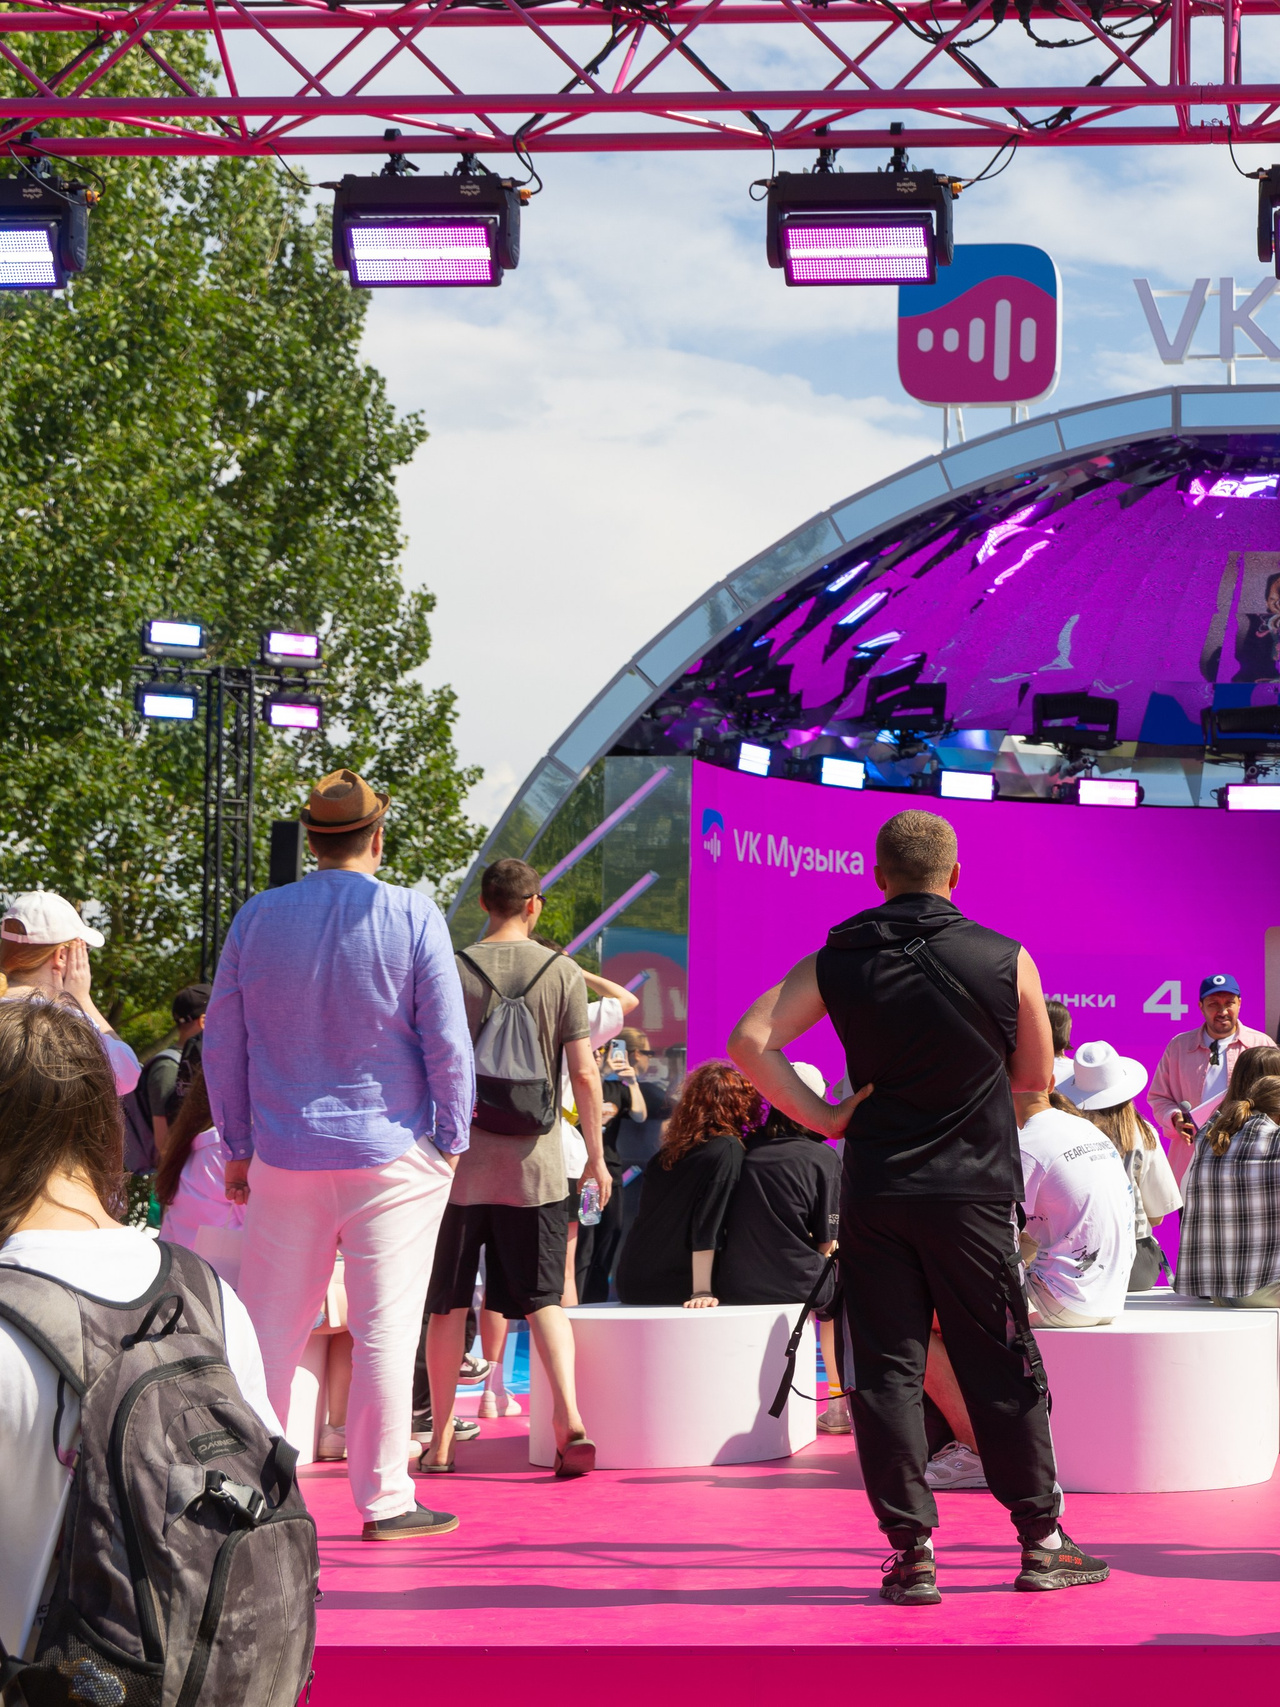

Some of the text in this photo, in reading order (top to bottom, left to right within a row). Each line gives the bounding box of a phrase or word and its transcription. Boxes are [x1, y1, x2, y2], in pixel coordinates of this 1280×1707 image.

[733, 828, 864, 877] VK Музыка
[1143, 980, 1189, 1021] 4
